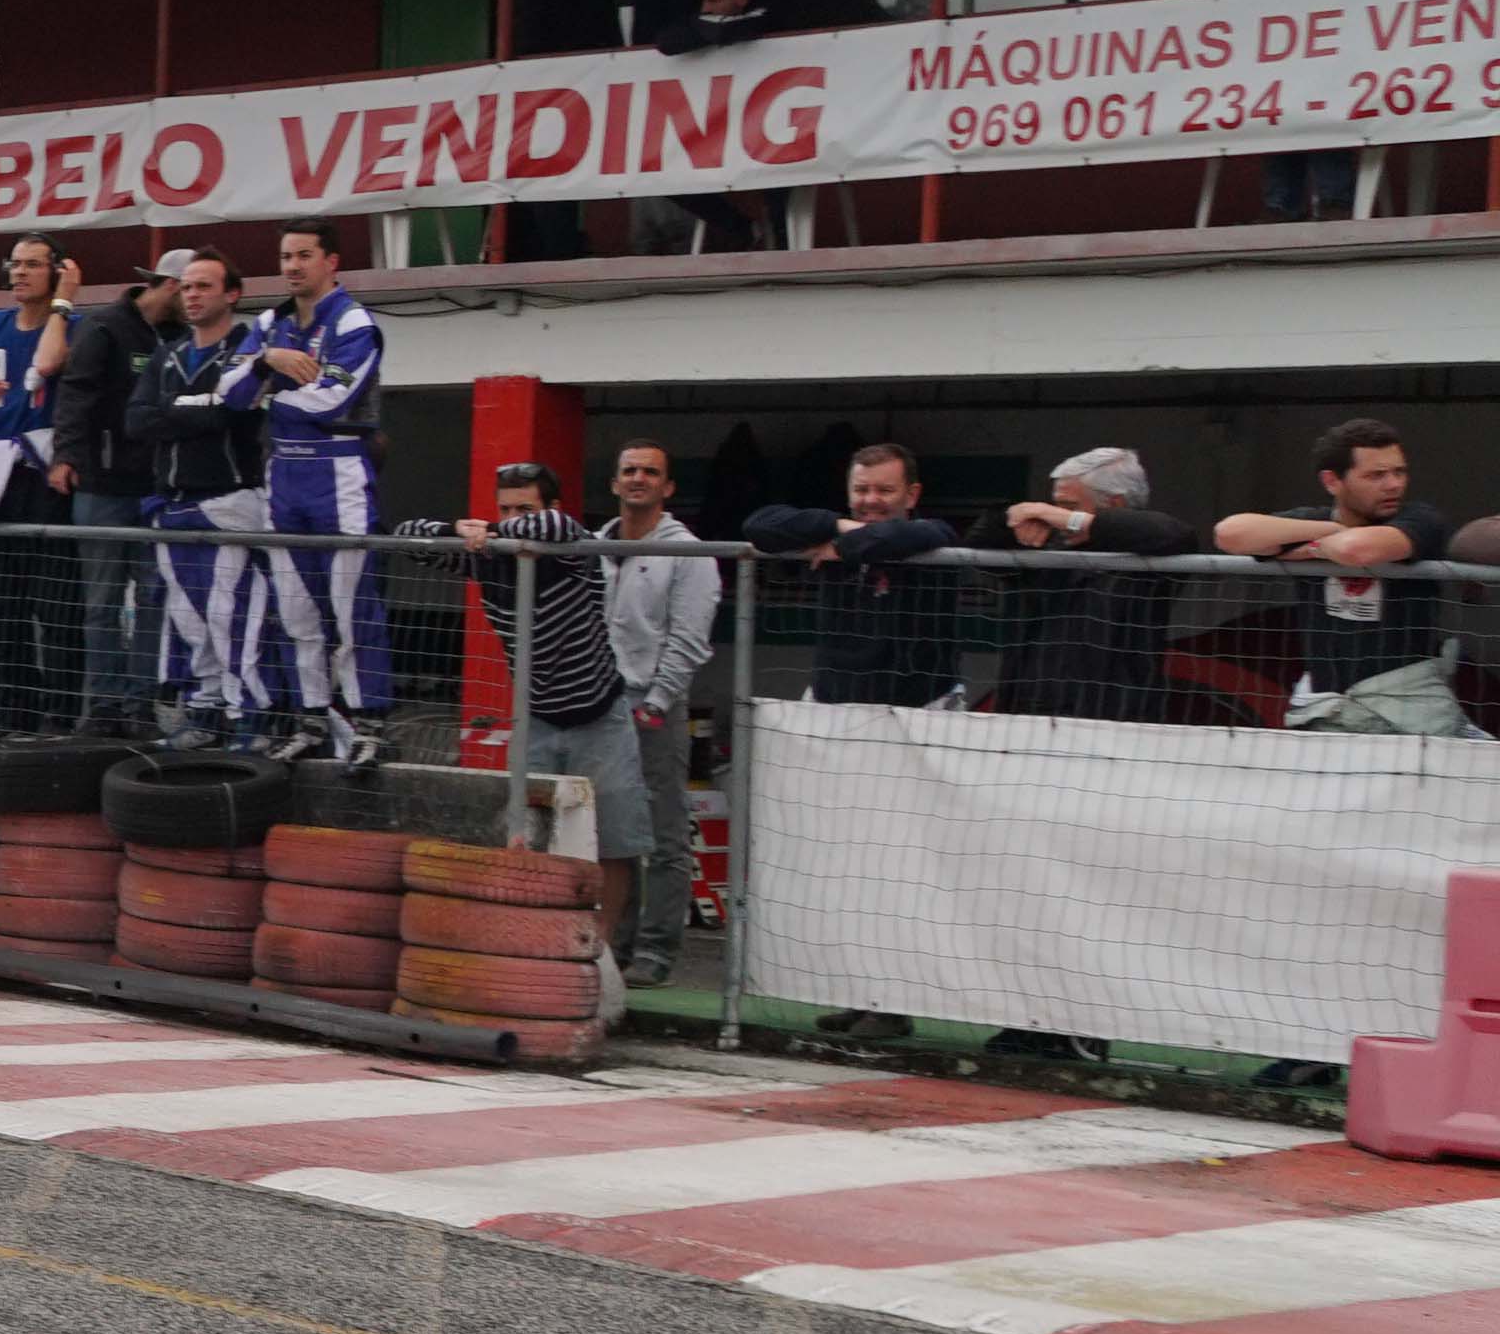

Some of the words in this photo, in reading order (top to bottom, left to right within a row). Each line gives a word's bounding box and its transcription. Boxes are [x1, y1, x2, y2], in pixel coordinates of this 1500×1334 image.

[907, 20, 1234, 92] MÁQUINAS
[1256, 8, 1345, 63] DE
[278, 65, 828, 201] VENDING
[947, 100, 1041, 151] 969
[1063, 91, 1158, 143] 061
[1180, 80, 1283, 134] 234
[1347, 63, 1455, 120] 262
